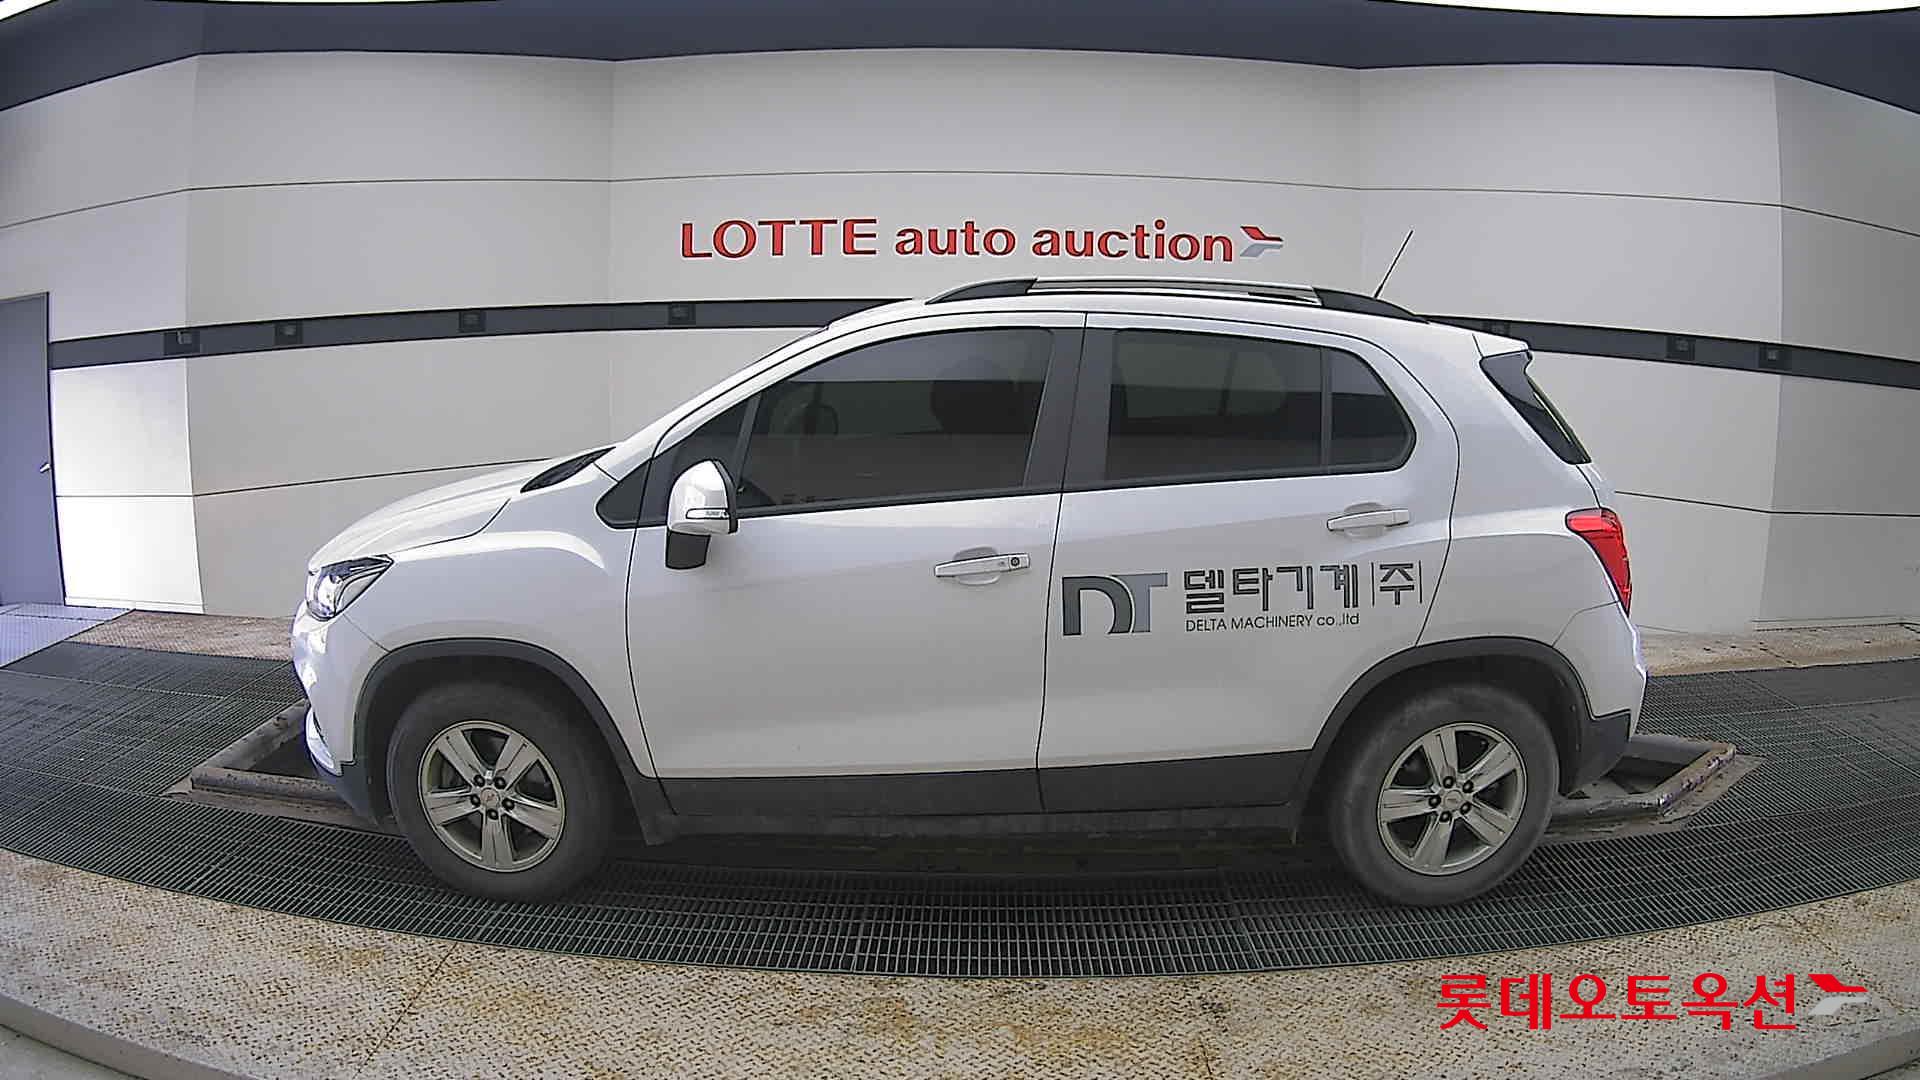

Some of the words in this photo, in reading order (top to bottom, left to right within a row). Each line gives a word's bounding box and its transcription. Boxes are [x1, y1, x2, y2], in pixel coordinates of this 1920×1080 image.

[681, 218, 878, 258] LOTTE
[895, 221, 1017, 256] auto
[1031, 218, 1234, 263] auction
[1183, 564, 1360, 614] 델타기계
[1185, 618, 1227, 632] DELTA
[1231, 614, 1313, 631] MACHINERY
